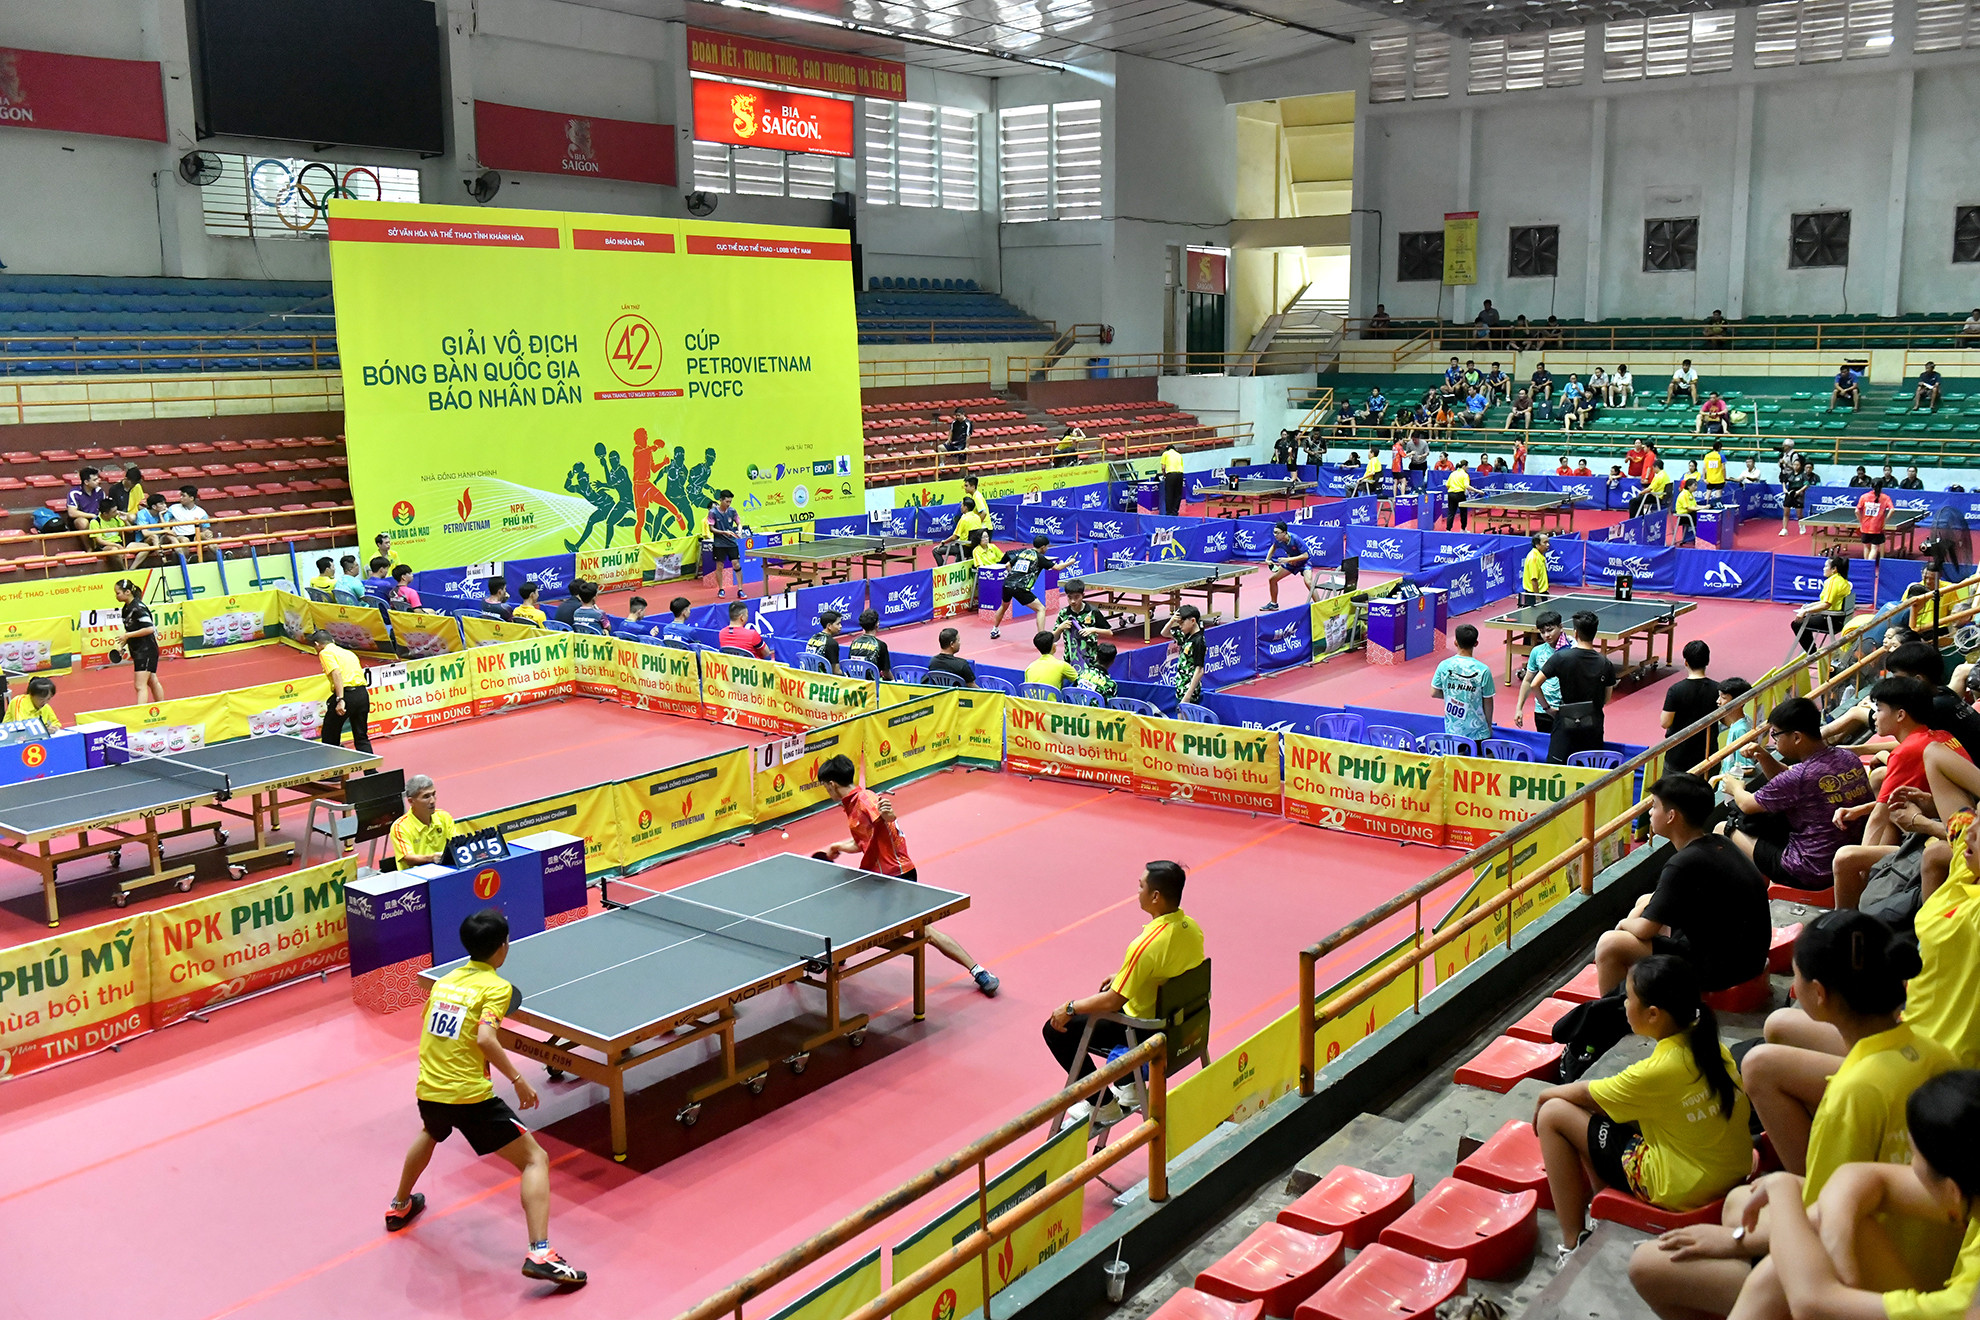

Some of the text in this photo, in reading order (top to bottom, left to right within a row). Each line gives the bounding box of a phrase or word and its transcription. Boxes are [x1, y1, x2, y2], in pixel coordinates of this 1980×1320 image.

[692, 38, 718, 63] ĐOÀN
[720, 39, 740, 68] KẾT,
[743, 49, 772, 73] TRUNG
[775, 54, 800, 80] THỰC,
[803, 60, 820, 81] CAO
[823, 62, 856, 88] THƯỢNG
[871, 64, 889, 90] TIẾN
[891, 70, 903, 96] BỘ
[782, 106, 800, 119] BIA
[562, 157, 600, 173] SAIGON
[574, 152, 586, 162] BIA
[388, 228, 524, 241] SỞ VĂN HÓA VÀ THỂ THAO TỈNH KHÁNH HÒA
[441, 328, 578, 358] GIẢI VÔ ĐỊCH
[612, 324, 652, 370] 42
[684, 333, 721, 352] CÚP
[362, 352, 580, 388] BÓNG BÀN QUỐC GIA
[686, 356, 812, 376] PETROVIETNAM
[428, 380, 583, 412] BÁO NHÂN DÂN
[688, 380, 744, 400] PVCFC
[421, 469, 498, 482] NHÀ ĐỒNG HÀNH CHÍNH
[786, 466, 811, 475] VNPT
[990, 488, 1015, 498] VÔ ĐỊCH
[1053, 481, 1066, 490] CÚP
[444, 520, 491, 534] PETROVIETNAM
[1030, 526, 1048, 534] DOUBLE
[747, 540, 753, 549] 6
[1360, 550, 1384, 559] DOUBLE
[1609, 557, 1623, 566] 双鱼
[1016, 563, 1028, 572] 076
[1549, 564, 1564, 572] FISH
[1602, 566, 1654, 579] DOUBLE FISH
[8, 590, 23, 600] THỂ
[25, 590, 44, 598] THAO
[70, 585, 86, 594] VIỆT
[550, 580, 563, 590] FISH
[1411, 584, 1418, 594] 8
[1620, 587, 1629, 598] T
[1704, 581, 1742, 589] MOFIT
[89, 610, 98, 626] 0
[884, 604, 904, 614] DOUBLE
[477, 638, 569, 674] NPK PHÚ MỸ
[618, 649, 690, 678] NPK PHÚ MỸ
[382, 668, 406, 678] TÂY NINH
[440, 656, 465, 681] MỸ
[706, 660, 758, 688] NPK PHÚ
[1204, 662, 1224, 674] DOUBLE
[480, 668, 552, 691] Cho mùa bội
[620, 670, 692, 695] Cho mùa thu
[395, 685, 468, 706] mùa bội thu
[708, 684, 724, 698] Cho
[780, 678, 868, 710] NPK PHÚ MỸ
[658, 701, 670, 711] TIN
[1446, 702, 1466, 718] 009
[26, 718, 45, 736] 11
[1012, 708, 1126, 742] NPK PHÚ MỸ
[784, 746, 804, 760] VŨNG TÀU
[1140, 728, 1268, 764] NPK PHÚ MỸ
[27, 746, 42, 766] 8
[765, 744, 773, 767] 0
[1040, 761, 1062, 776] 20
[140, 800, 196, 820] MOFIT
[507, 808, 568, 831] NHÀ ĐỒNG HÀNH CHÍNH
[457, 846, 473, 864] 3
[488, 837, 502, 856] 5
[544, 858, 584, 875] Double FISH
[479, 872, 495, 896] 7
[163, 869, 348, 956] NPK PHÚ MỸ
[347, 905, 362, 916] Double
[380, 902, 426, 920] Double FISH
[0, 948, 69, 1000] PHÚ
[728, 974, 788, 1006] MOFIT
[49, 979, 135, 1020] bội thu
[430, 1012, 458, 1037] 164
[41, 1012, 141, 1059] TIN DÙNG
[514, 1038, 572, 1068] DOUBLE FISH
[1048, 1219, 1063, 1240] NPK
[1038, 1239, 1056, 1265] PHÚ
